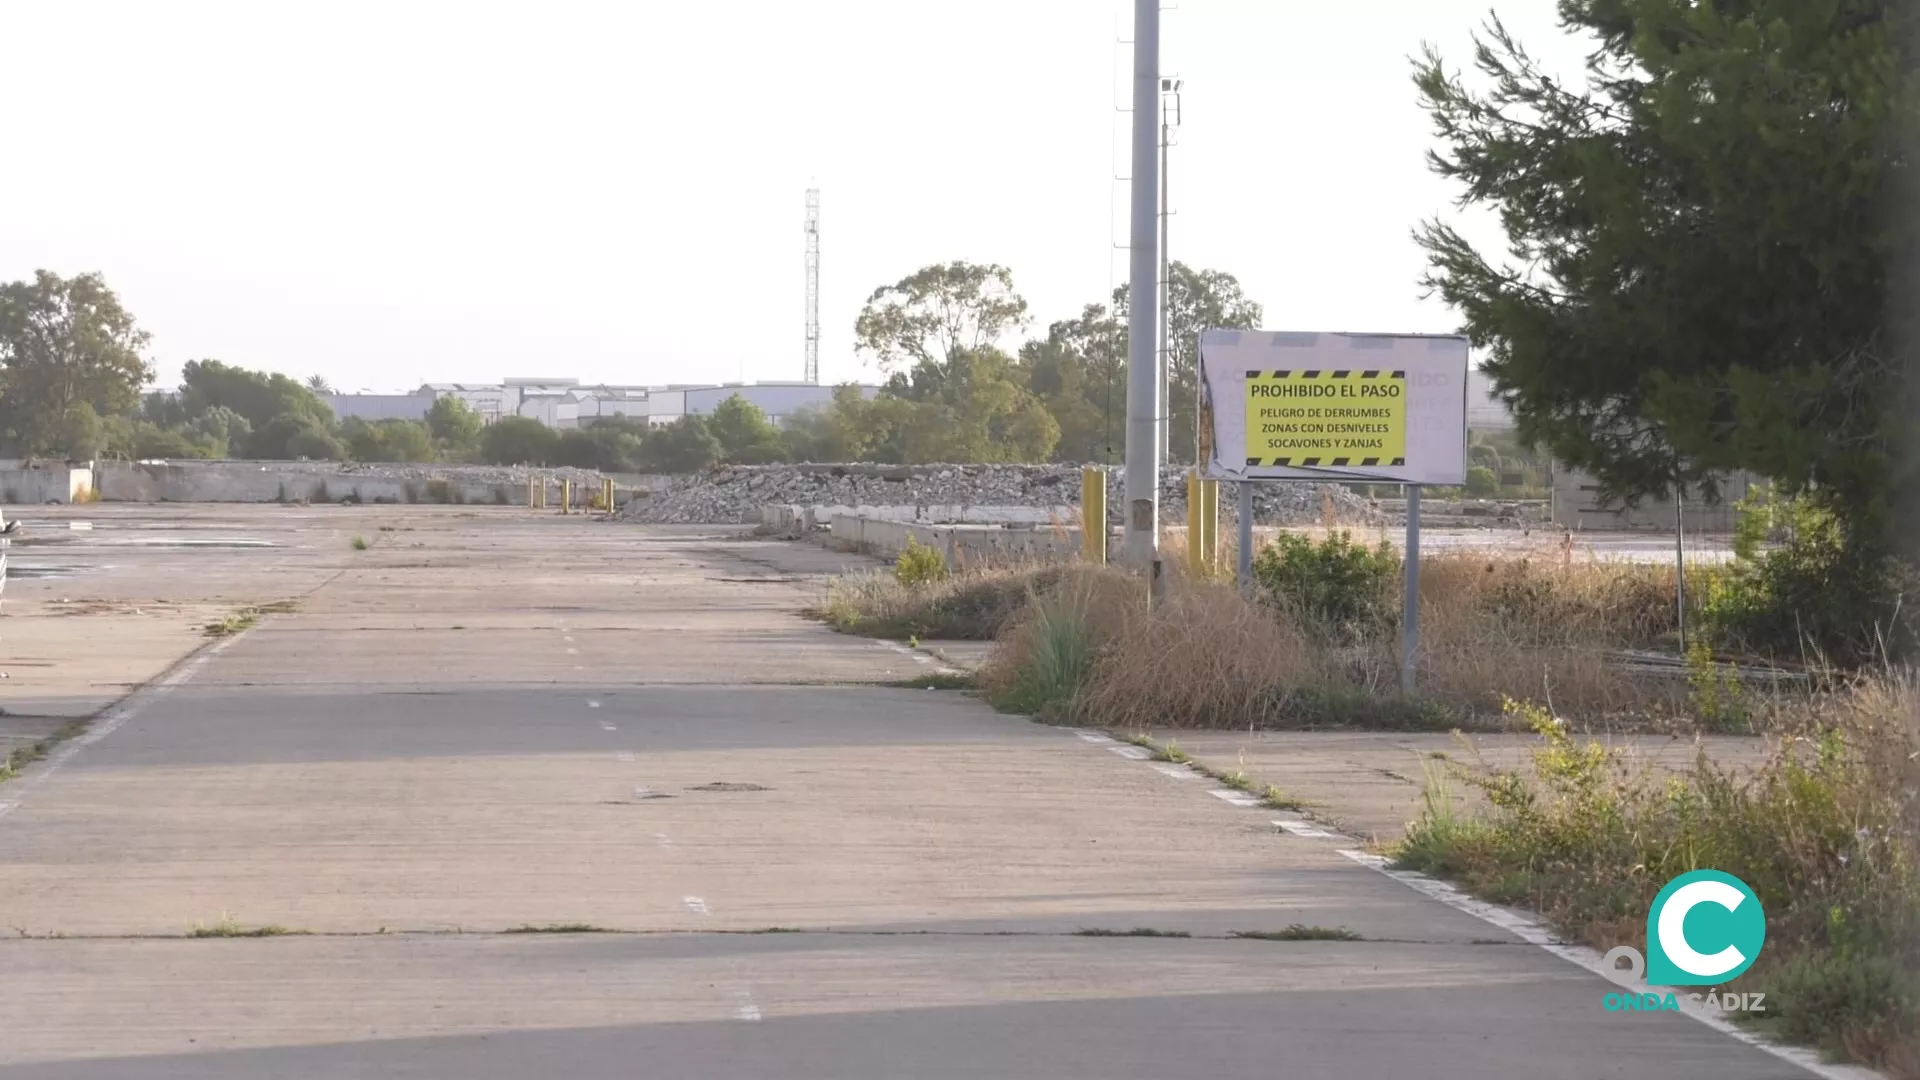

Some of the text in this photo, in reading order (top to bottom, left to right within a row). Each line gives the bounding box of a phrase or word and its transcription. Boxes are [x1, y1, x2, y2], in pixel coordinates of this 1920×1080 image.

[1251, 384, 1400, 398] PROHIBIDO EL PASO
[1260, 408, 1391, 418] PELIGRO DE DERRUMBES
[1261, 423, 1389, 433] ZONAS CON DESNIVELES
[1267, 438, 1383, 448] SOCAVONES Y ZANJAS
